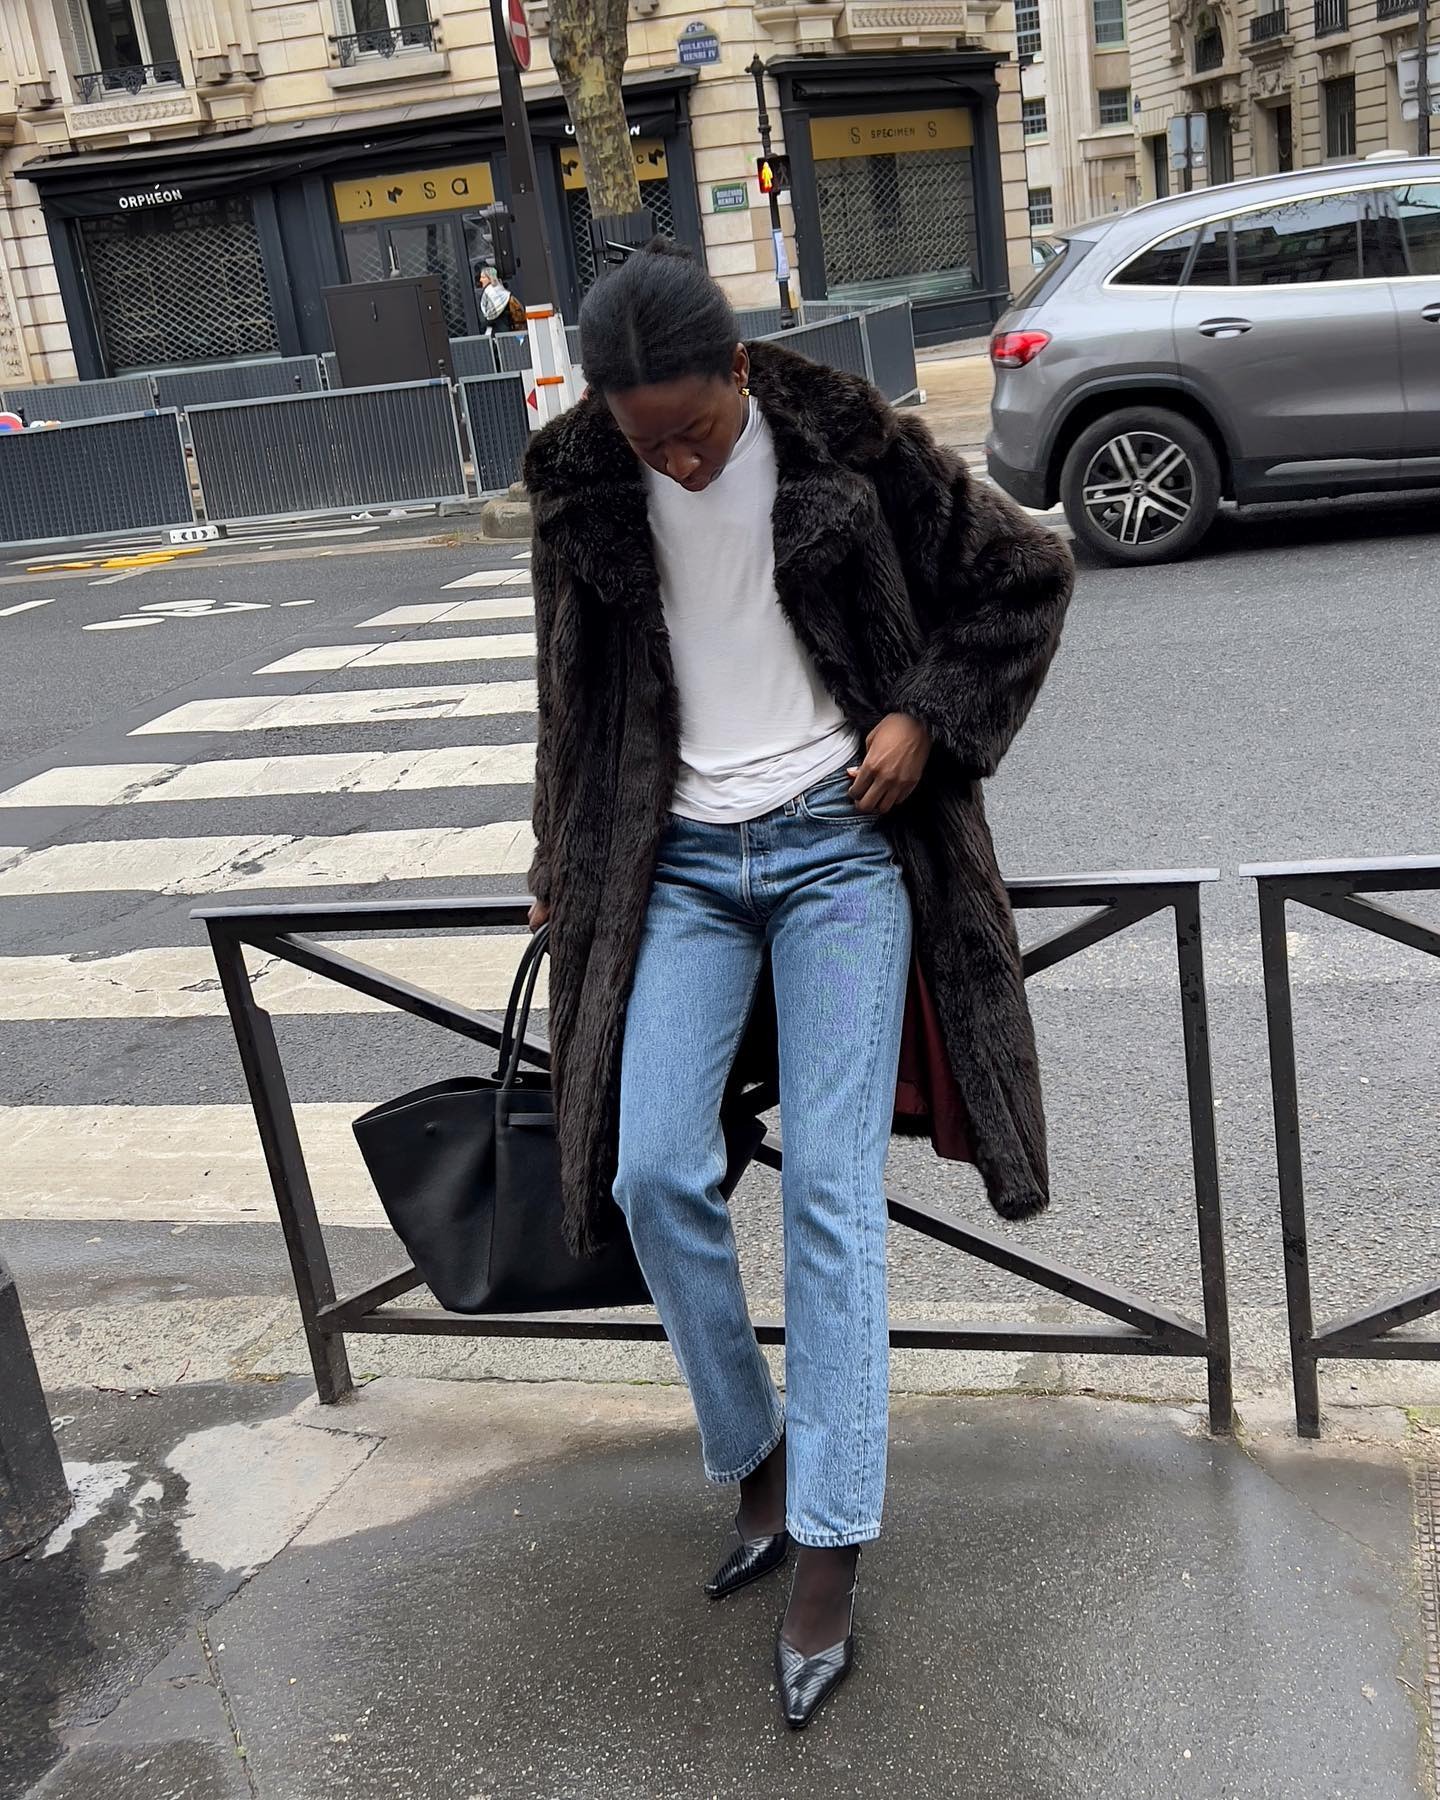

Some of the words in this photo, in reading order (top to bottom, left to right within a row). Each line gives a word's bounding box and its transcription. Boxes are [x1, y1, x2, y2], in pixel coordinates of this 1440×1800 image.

[683, 50, 707, 62] HENRI
[707, 49, 717, 58] IV
[870, 127, 916, 139] SPECIMEN
[118, 183, 183, 209] ORPHÉON
